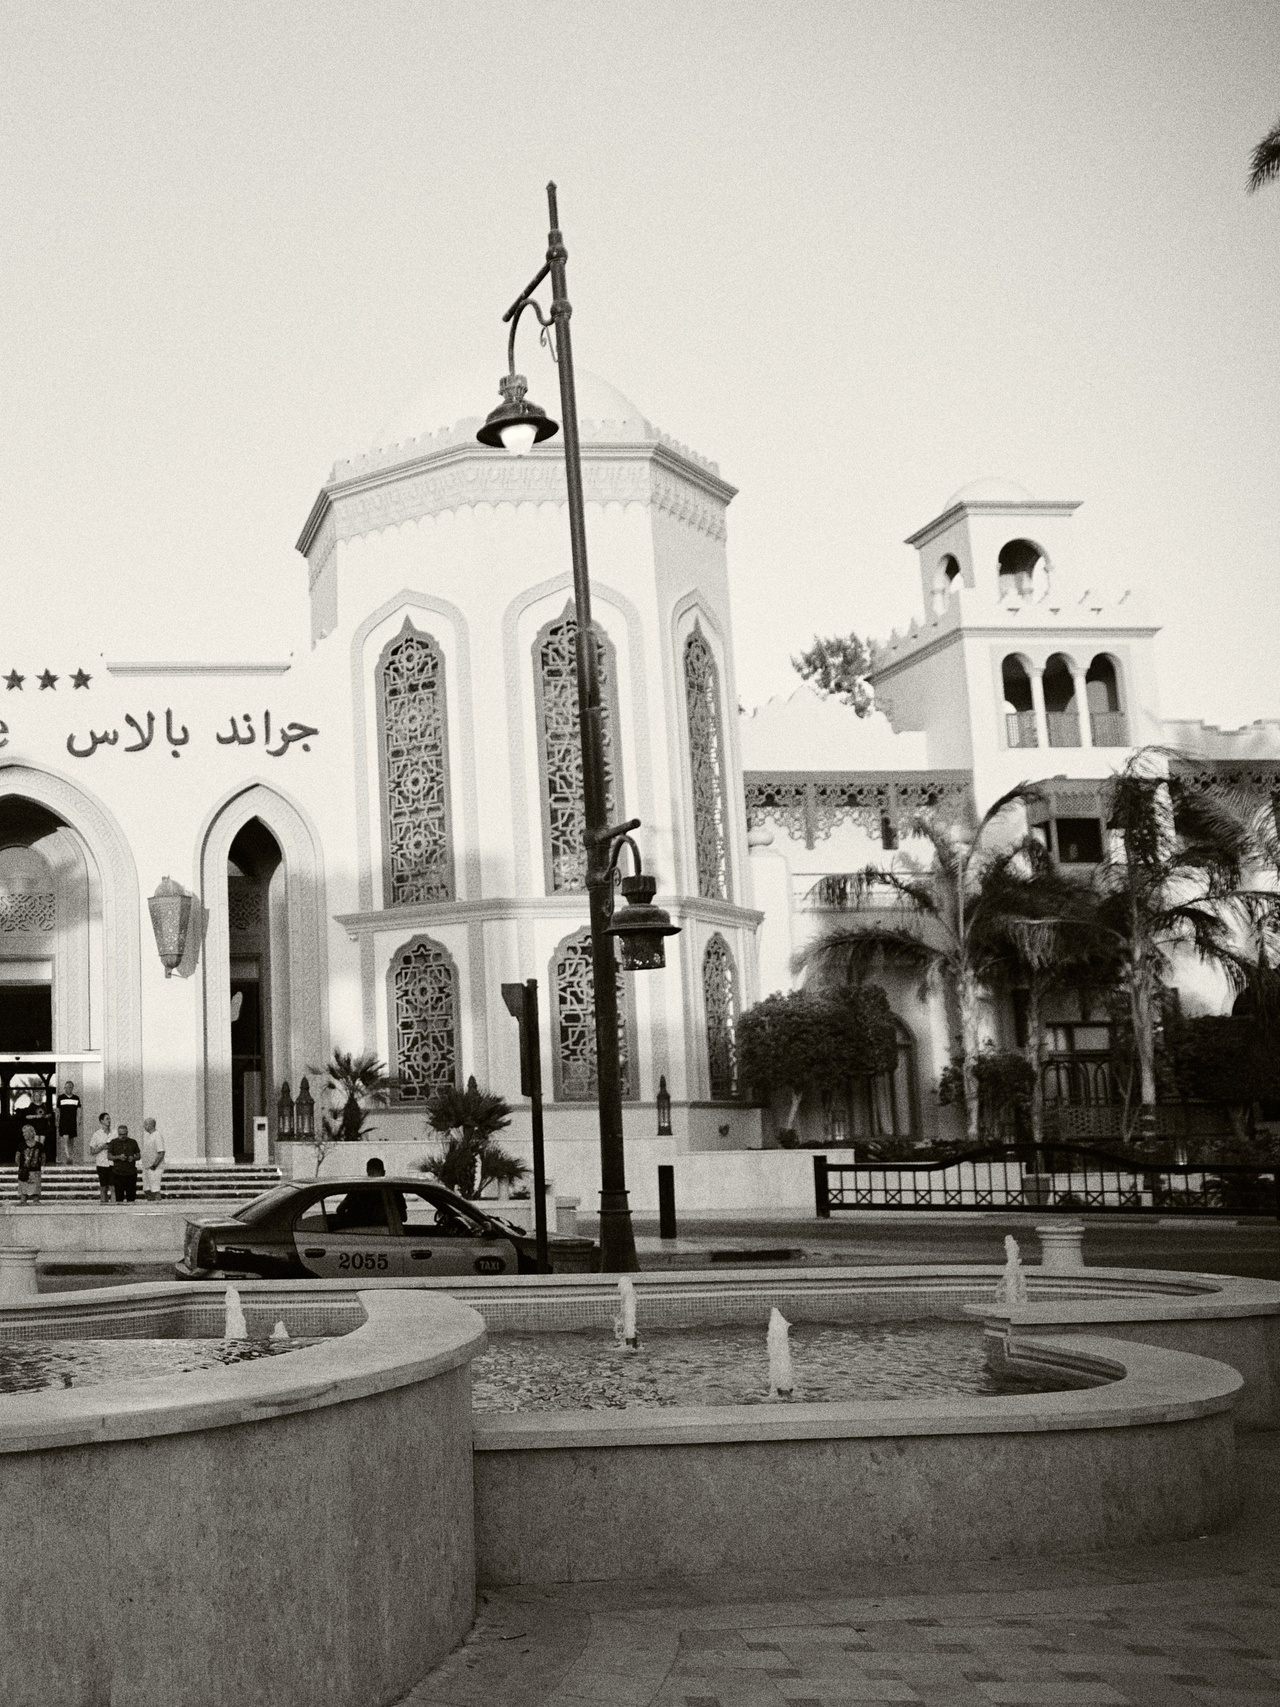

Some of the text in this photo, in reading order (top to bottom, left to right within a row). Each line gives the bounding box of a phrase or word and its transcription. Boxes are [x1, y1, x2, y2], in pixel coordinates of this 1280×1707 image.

[66, 707, 319, 758] جراند بالاس
[339, 1252, 388, 1270] 2055
[479, 1260, 500, 1270] TAXI
